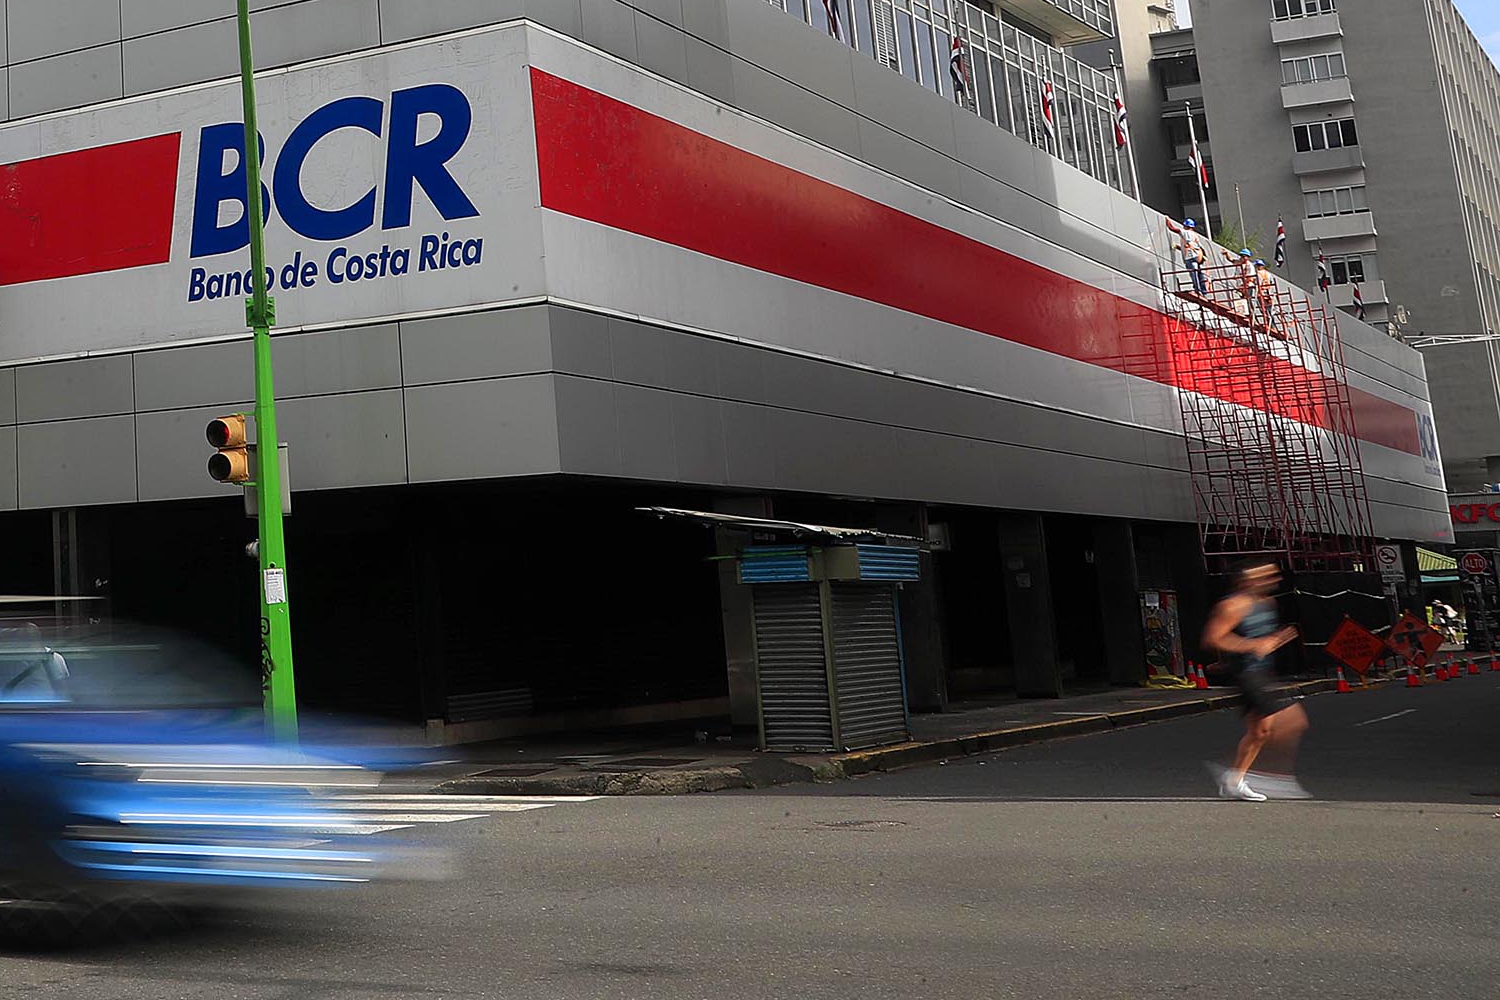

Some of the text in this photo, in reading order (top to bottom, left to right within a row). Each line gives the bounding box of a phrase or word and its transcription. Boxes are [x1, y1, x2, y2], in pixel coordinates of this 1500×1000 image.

[189, 83, 481, 259] BCR
[280, 251, 318, 291] de
[326, 244, 410, 284] Costa
[418, 231, 484, 272] Rica
[1464, 558, 1485, 569] ALTO
